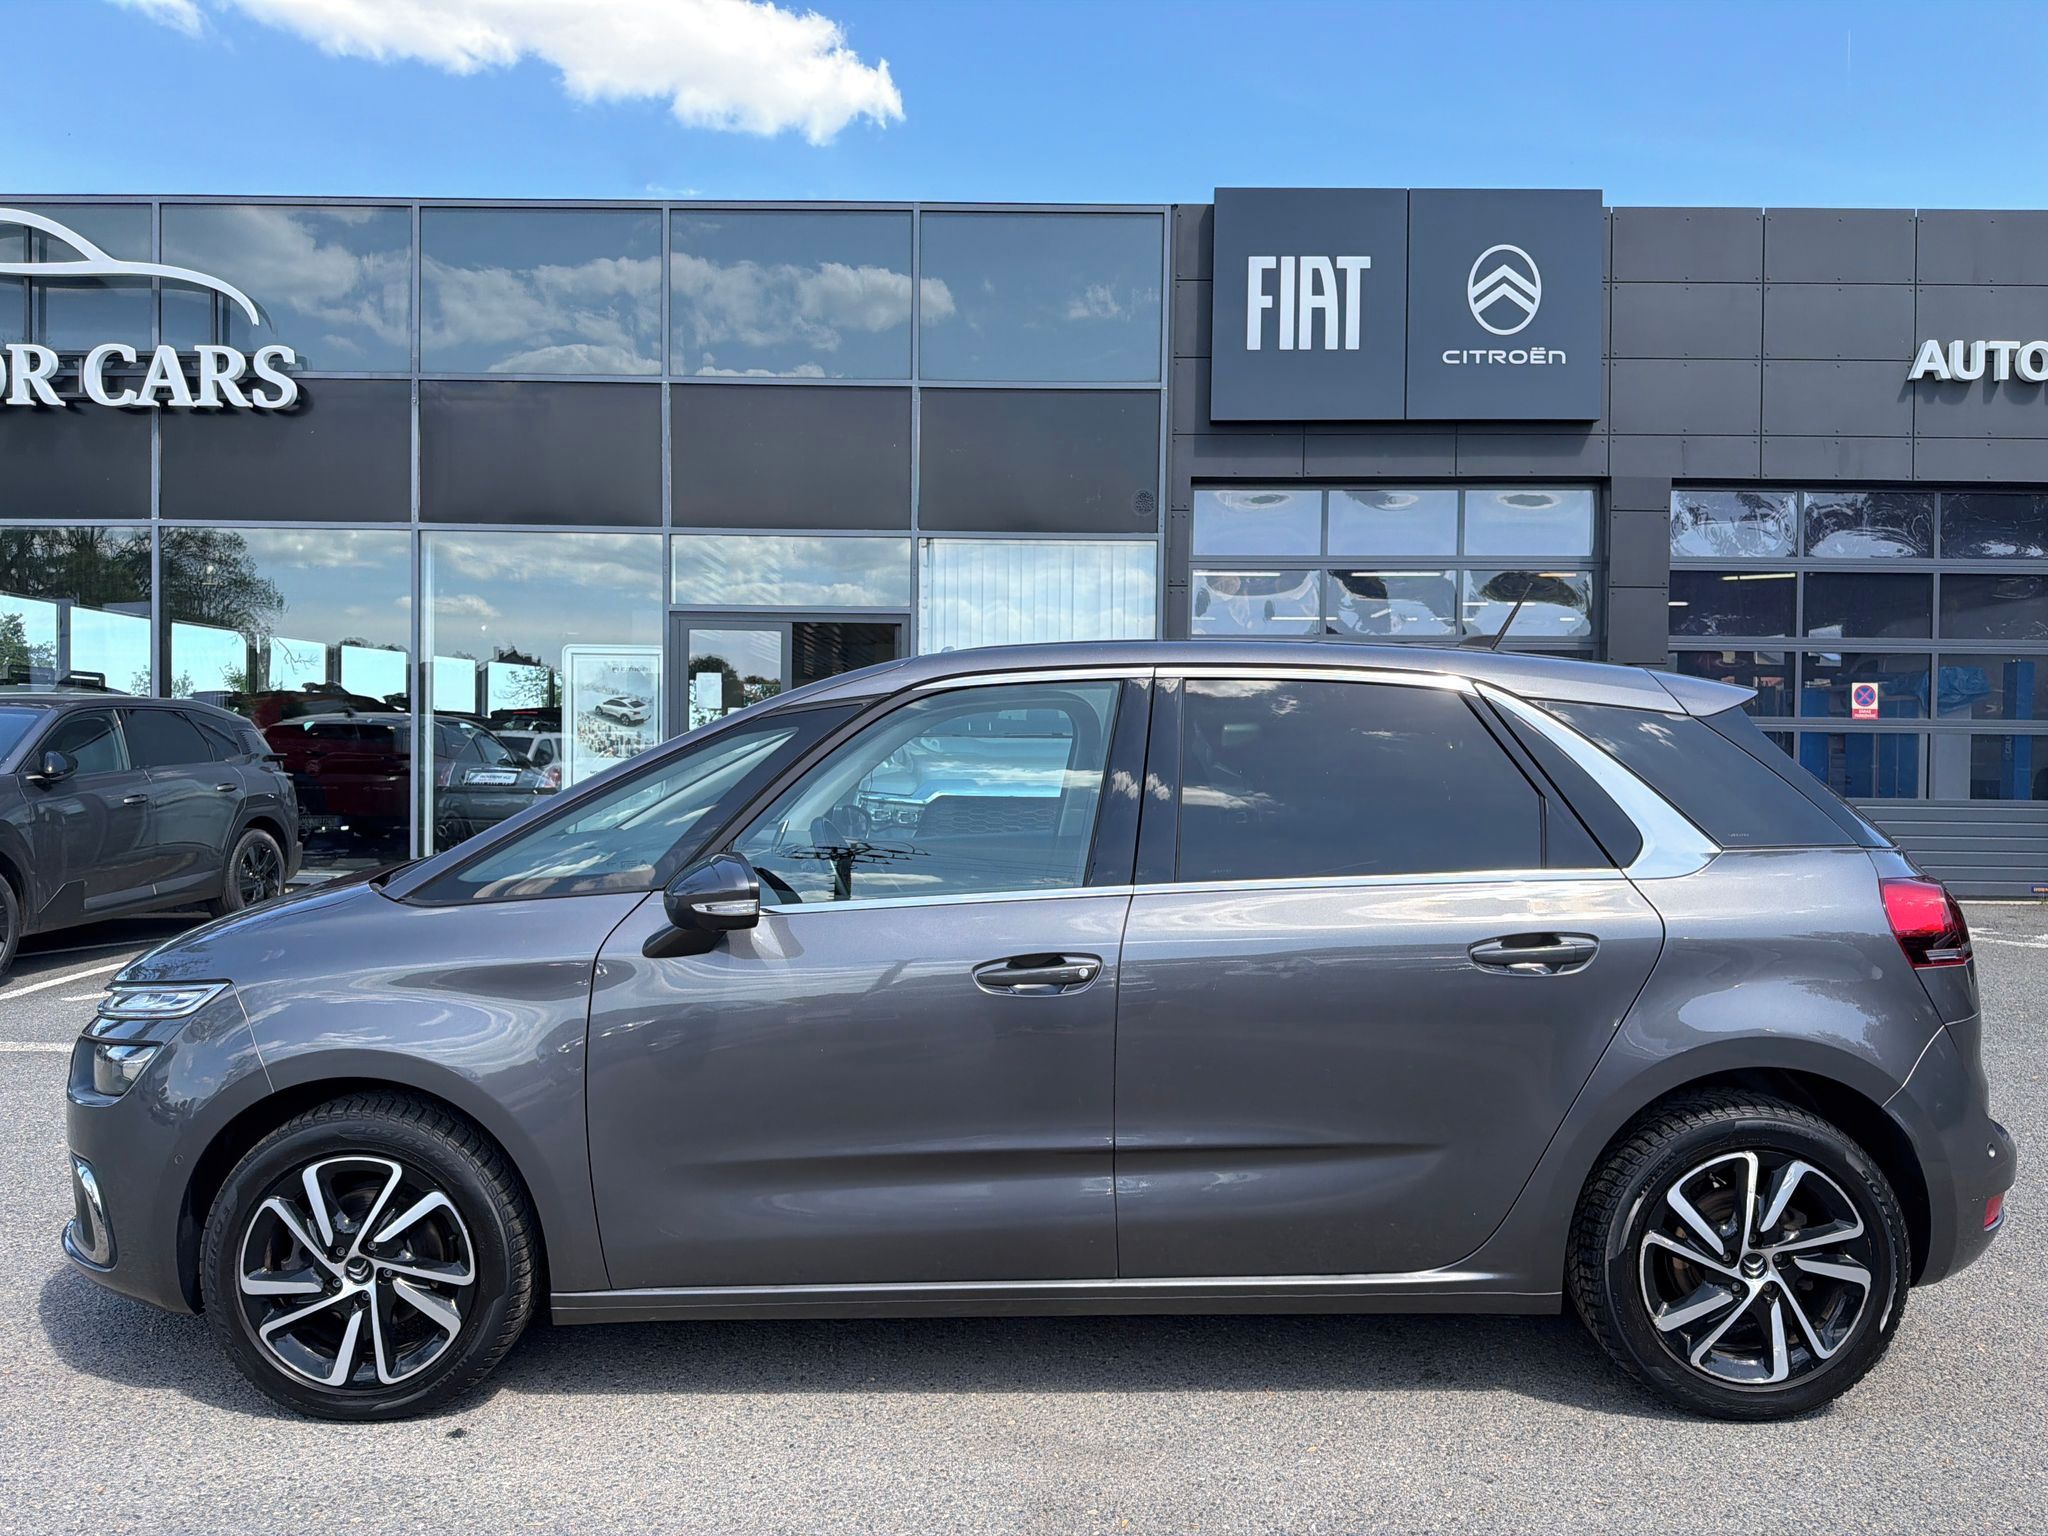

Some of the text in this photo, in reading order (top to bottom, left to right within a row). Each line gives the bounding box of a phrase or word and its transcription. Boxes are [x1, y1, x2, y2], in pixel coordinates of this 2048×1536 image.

[1246, 255, 1371, 350] FIAT
[0, 343, 298, 409] R CARS
[1442, 346, 1567, 365] CITROËN
[1907, 339, 2048, 383] AUTO
